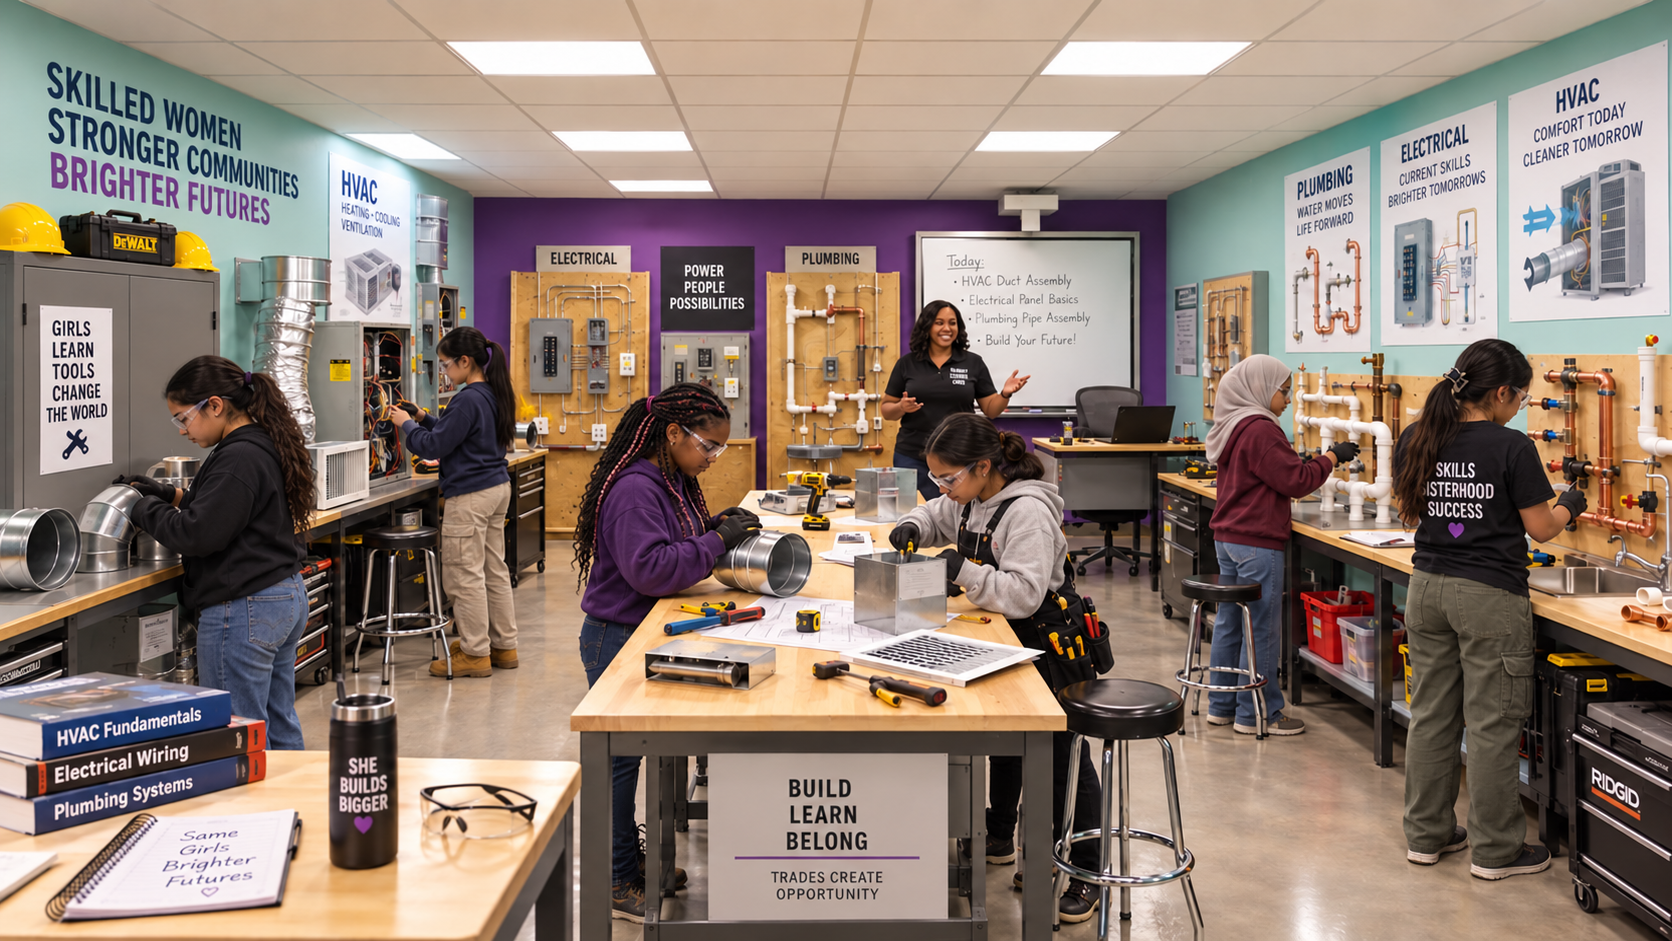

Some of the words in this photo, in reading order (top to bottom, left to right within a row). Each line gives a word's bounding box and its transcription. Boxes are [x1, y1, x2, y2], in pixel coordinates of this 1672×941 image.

[1555, 77, 1600, 113] HVAC
[46, 61, 155, 125] SKILLED
[163, 98, 242, 151] WOMEN
[1533, 117, 1585, 143] COMFORT
[1588, 102, 1626, 126] TODAY
[1400, 124, 1469, 163] ELECTRICAL
[1523, 143, 1569, 167] CLEANER
[1573, 121, 1643, 153] TOMORROW
[48, 108, 179, 172] STRONGER
[186, 145, 299, 200] COMMUNITIES
[1399, 164, 1438, 187] CURRENT
[1440, 153, 1471, 177] SKILLS
[50, 151, 180, 209] BRIGHTER
[187, 181, 271, 226] FUTURES
[341, 169, 378, 204] HVAC
[1297, 164, 1353, 200] PLUMBING
[1388, 188, 1428, 208] BRIGHTER
[1430, 170, 1486, 196] TOMORROWS
[341, 201, 369, 221] HEATING
[374, 209, 401, 227] COOLING
[1297, 201, 1323, 219] WATER
[1325, 193, 1354, 212] MOVES
[341, 219, 383, 238] VENTILATION
[1296, 219, 1313, 236] LIFE
[1314, 211, 1354, 231] FORWARD
[550, 251, 617, 266] ELECTRICAL
[801, 252, 860, 266] PLUMBING
[947, 254, 985, 272] Today:
[684, 263, 724, 277] POWER
[684, 281, 725, 294] PEOPLE
[961, 275, 992, 287] HVAC
[997, 274, 1022, 287] Duct
[1026, 274, 1072, 289] Assembly
[669, 296, 745, 311] POSSIBILITIES
[969, 294, 1015, 306] Electrical
[1019, 294, 1044, 306] Panel
[1049, 294, 1079, 305] Basics
[52, 320, 90, 337] GIRLS
[975, 312, 1018, 329] Plumbing
[1022, 312, 1042, 327] Pipe
[1046, 312, 1091, 328] Assembly
[52, 341, 94, 359] LEARN
[985, 334, 1011, 346] Build
[1015, 334, 1037, 348] Your
[1041, 333, 1076, 346] Future!
[52, 363, 95, 381] TOOLS
[52, 385, 101, 402] CHANGE
[46, 406, 69, 424] THE
[71, 402, 108, 421] WORLD
[1436, 461, 1476, 479] SKILLS
[1427, 501, 1483, 519] SUCCESS
[56, 725, 100, 747] HVAC
[103, 706, 202, 738] Fundamentals
[54, 759, 133, 784] Electrical
[137, 743, 189, 769] Wiring
[348, 756, 377, 776] SHE
[339, 775, 388, 795] BUILDS
[788, 779, 852, 798] BUILD
[1591, 766, 1639, 809] RIDGID
[53, 791, 128, 821] Plumbing
[132, 776, 193, 803] Systems
[339, 793, 388, 813] BIGGER
[789, 805, 857, 824] LEARN
[179, 827, 239, 842] Same
[786, 831, 868, 851] BELONG
[179, 841, 230, 857] Girls
[162, 855, 257, 874] Brighter
[165, 872, 253, 888] Futures
[771, 871, 826, 883] TRADES
[830, 871, 883, 883] CREATE
[776, 888, 879, 900] OPPORTUNITY
